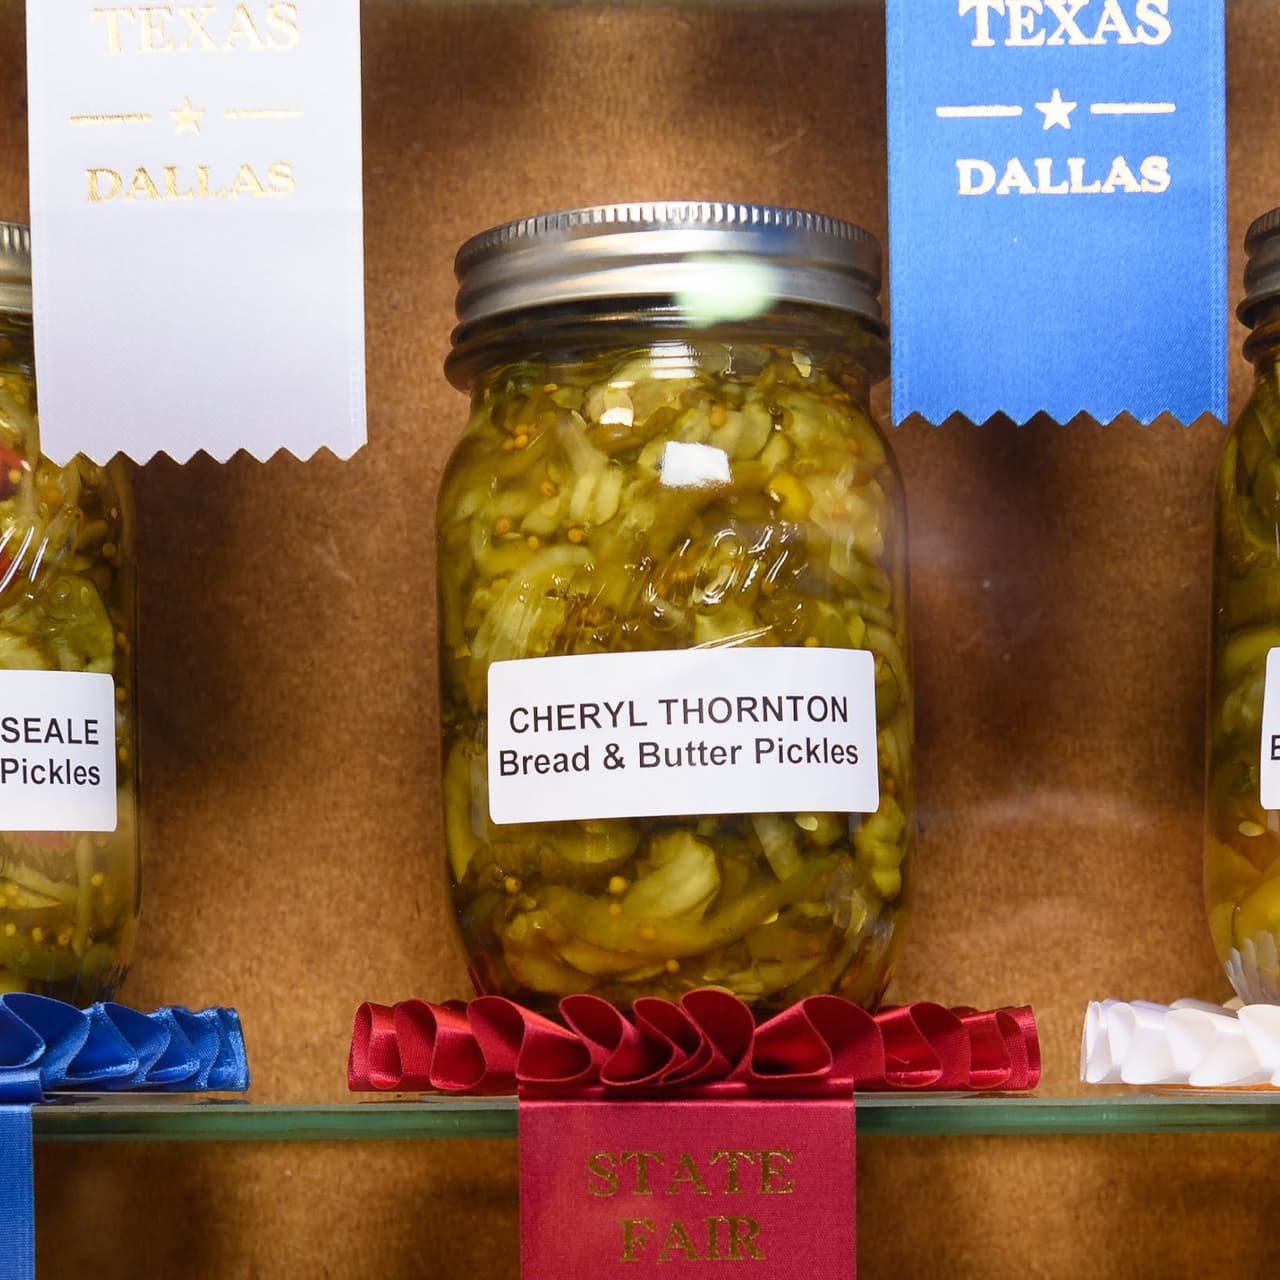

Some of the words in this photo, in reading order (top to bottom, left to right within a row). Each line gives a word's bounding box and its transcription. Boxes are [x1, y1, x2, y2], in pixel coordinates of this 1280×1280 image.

[89, 1, 300, 54] TEXAS
[958, 0, 1172, 47] TEXAS
[84, 160, 296, 202] DALLAS
[955, 155, 1171, 195] DALLAS
[1, 716, 100, 745] SEALE
[509, 700, 648, 733] CHERYL
[658, 695, 849, 725] THORNTON
[0, 757, 101, 786] Pickles
[500, 745, 590, 776] Bread
[602, 742, 625, 770] &
[638, 740, 742, 769] Butter
[754, 736, 859, 765] Pickles
[586, 1149, 796, 1197] STATE
[617, 1216, 767, 1262] FAIR
